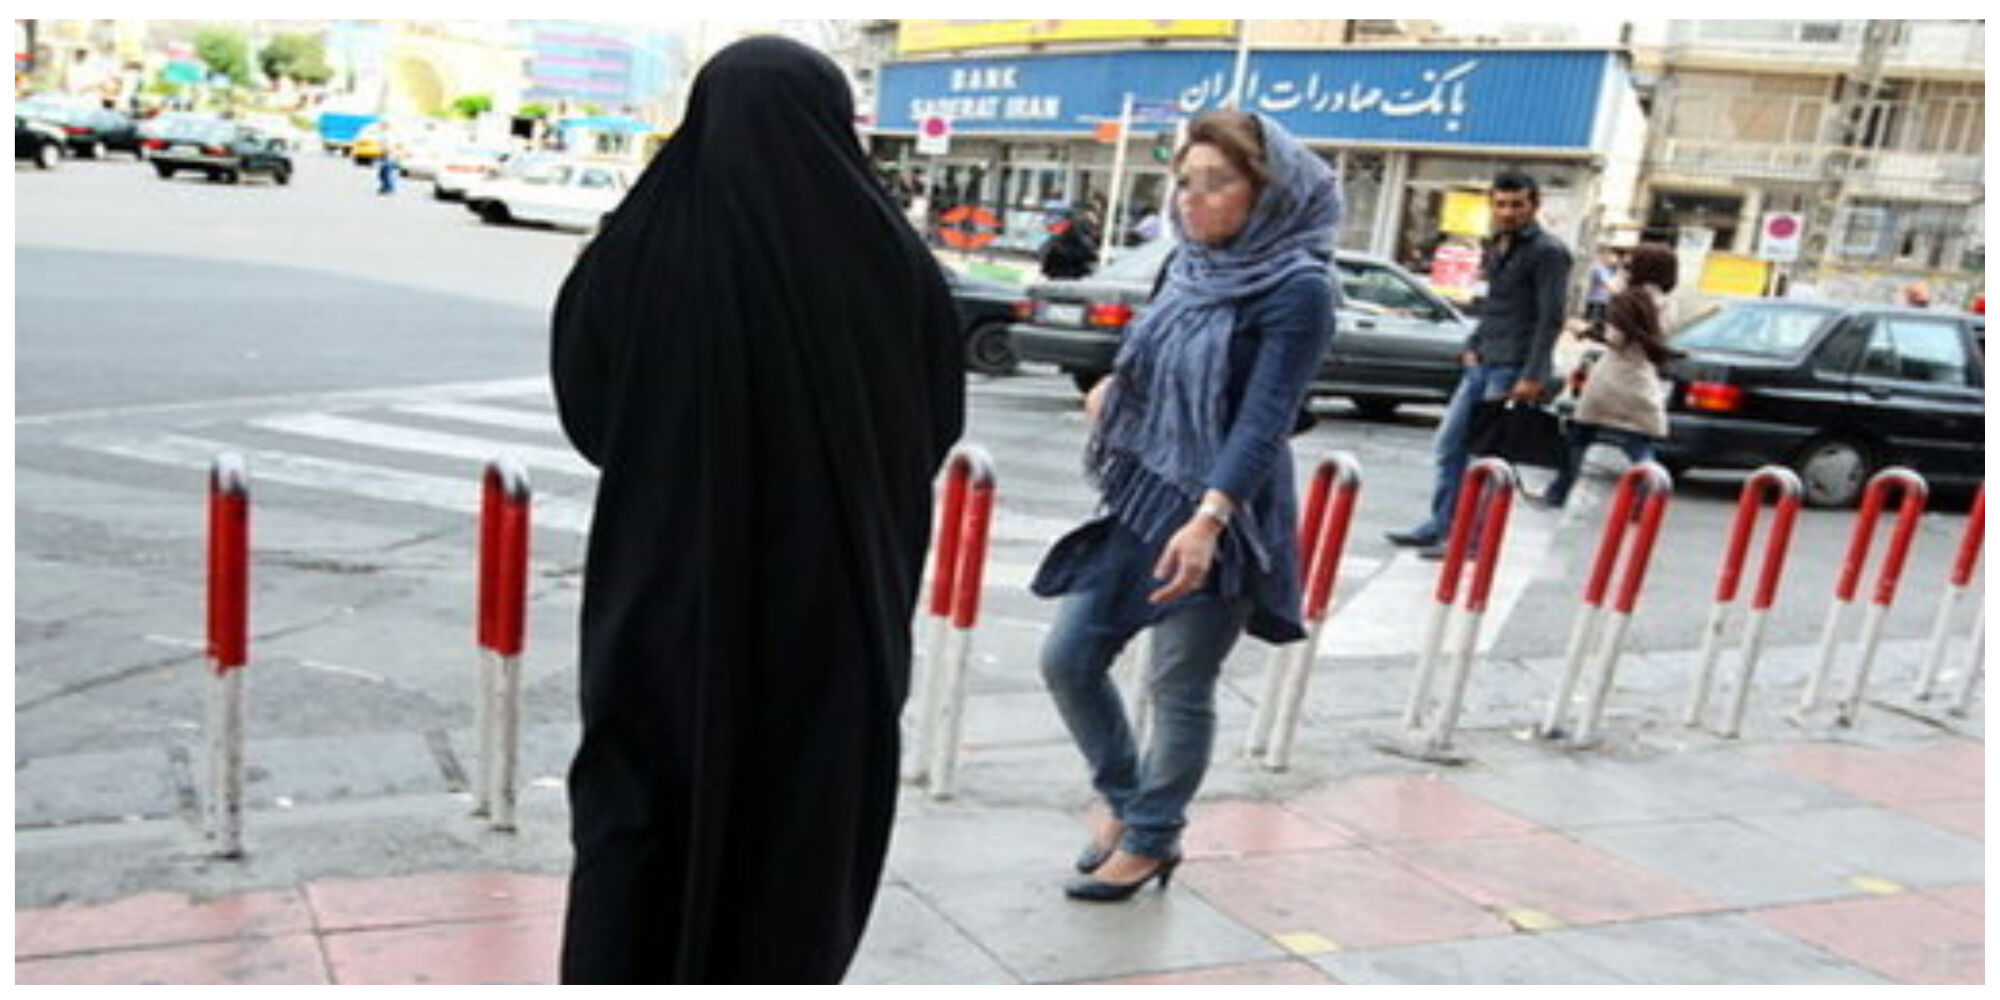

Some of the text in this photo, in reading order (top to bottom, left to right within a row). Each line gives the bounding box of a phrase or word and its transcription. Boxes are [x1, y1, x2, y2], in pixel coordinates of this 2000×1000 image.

[952, 67, 1018, 91] BANK
[1179, 58, 1478, 132] بانک صادرات اران
[1003, 96, 1060, 119] IRAN
